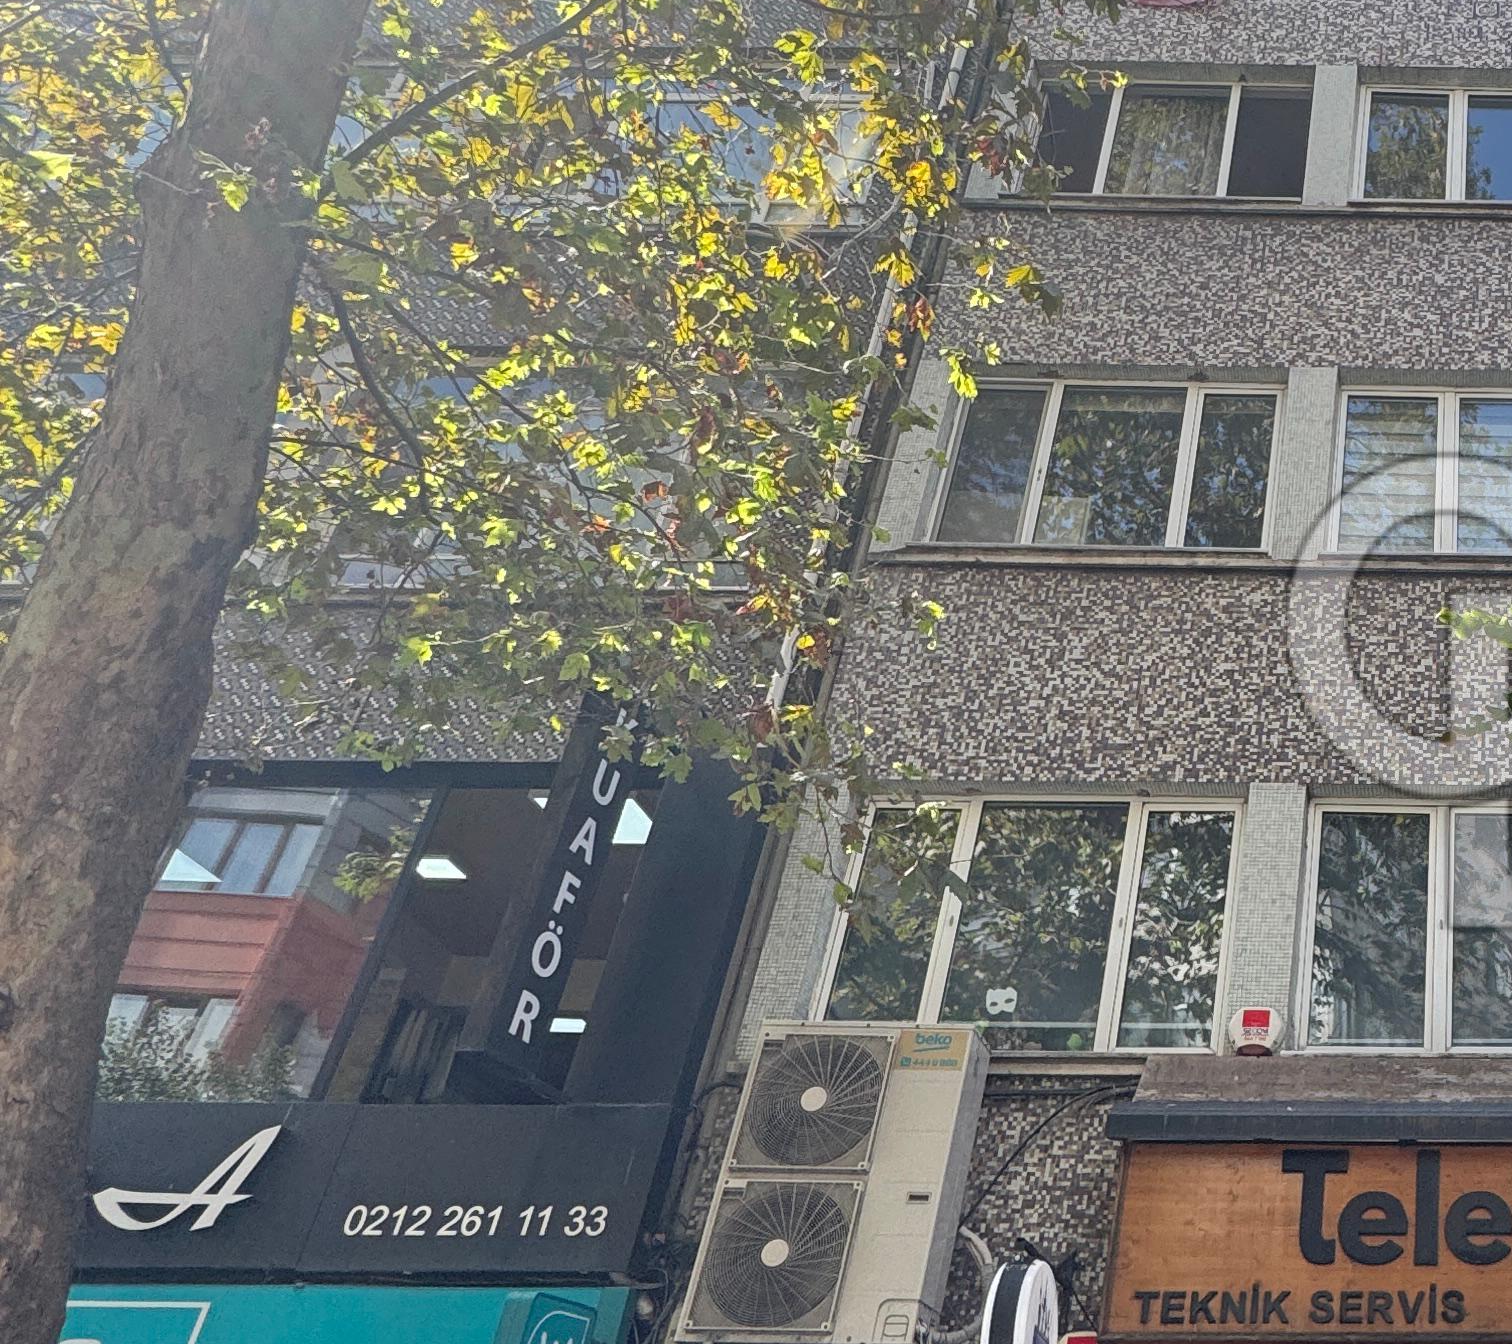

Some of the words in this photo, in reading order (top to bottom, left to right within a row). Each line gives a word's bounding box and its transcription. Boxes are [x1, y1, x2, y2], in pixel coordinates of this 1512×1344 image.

[915, 1033, 952, 1045] beko
[93, 1125, 282, 1231] A
[343, 1205, 431, 1237] 0212
[436, 1205, 503, 1237] 261
[518, 1205, 552, 1237] 11
[564, 1205, 608, 1237] 33
[1135, 1283, 1291, 1325] TEKNİK
[1309, 1283, 1467, 1325] SERVİS
